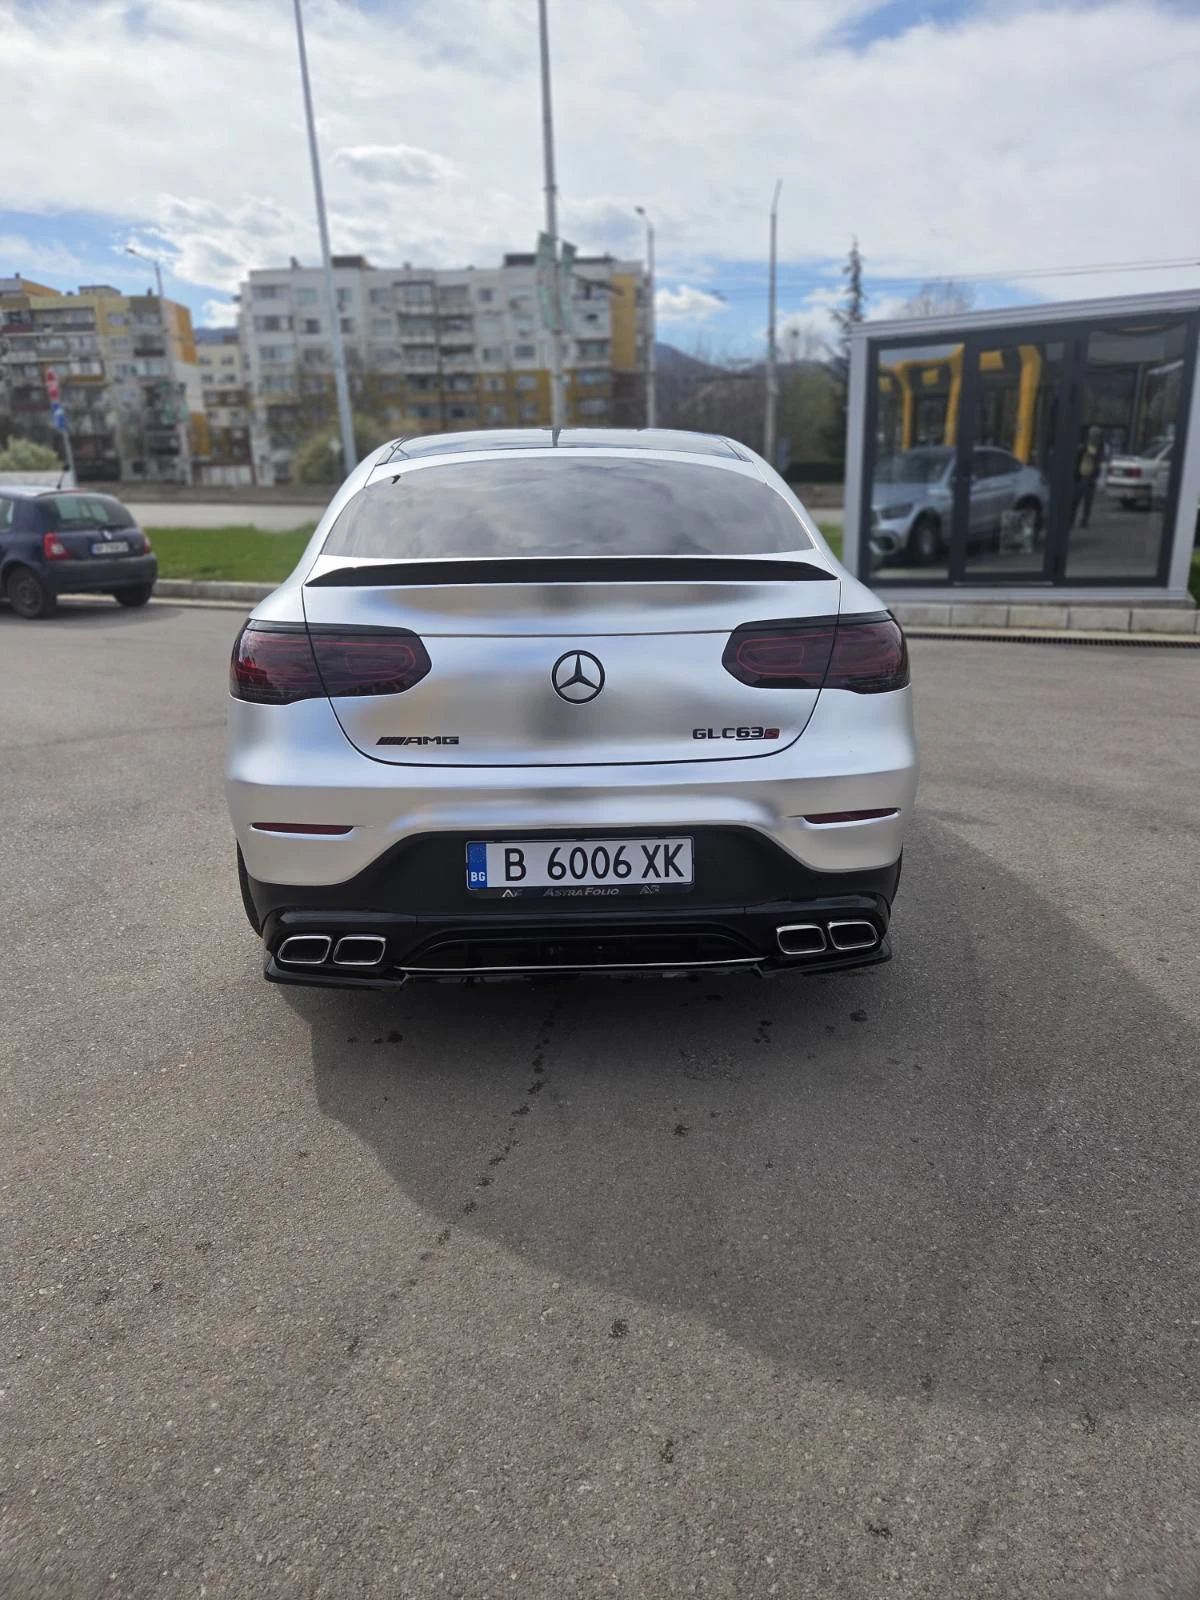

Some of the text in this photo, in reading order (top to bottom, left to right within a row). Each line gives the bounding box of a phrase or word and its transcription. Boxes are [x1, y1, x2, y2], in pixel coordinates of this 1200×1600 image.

[403, 736, 459, 745] AMG
[504, 843, 685, 882] B 6006 XK
[470, 871, 486, 882] BG
